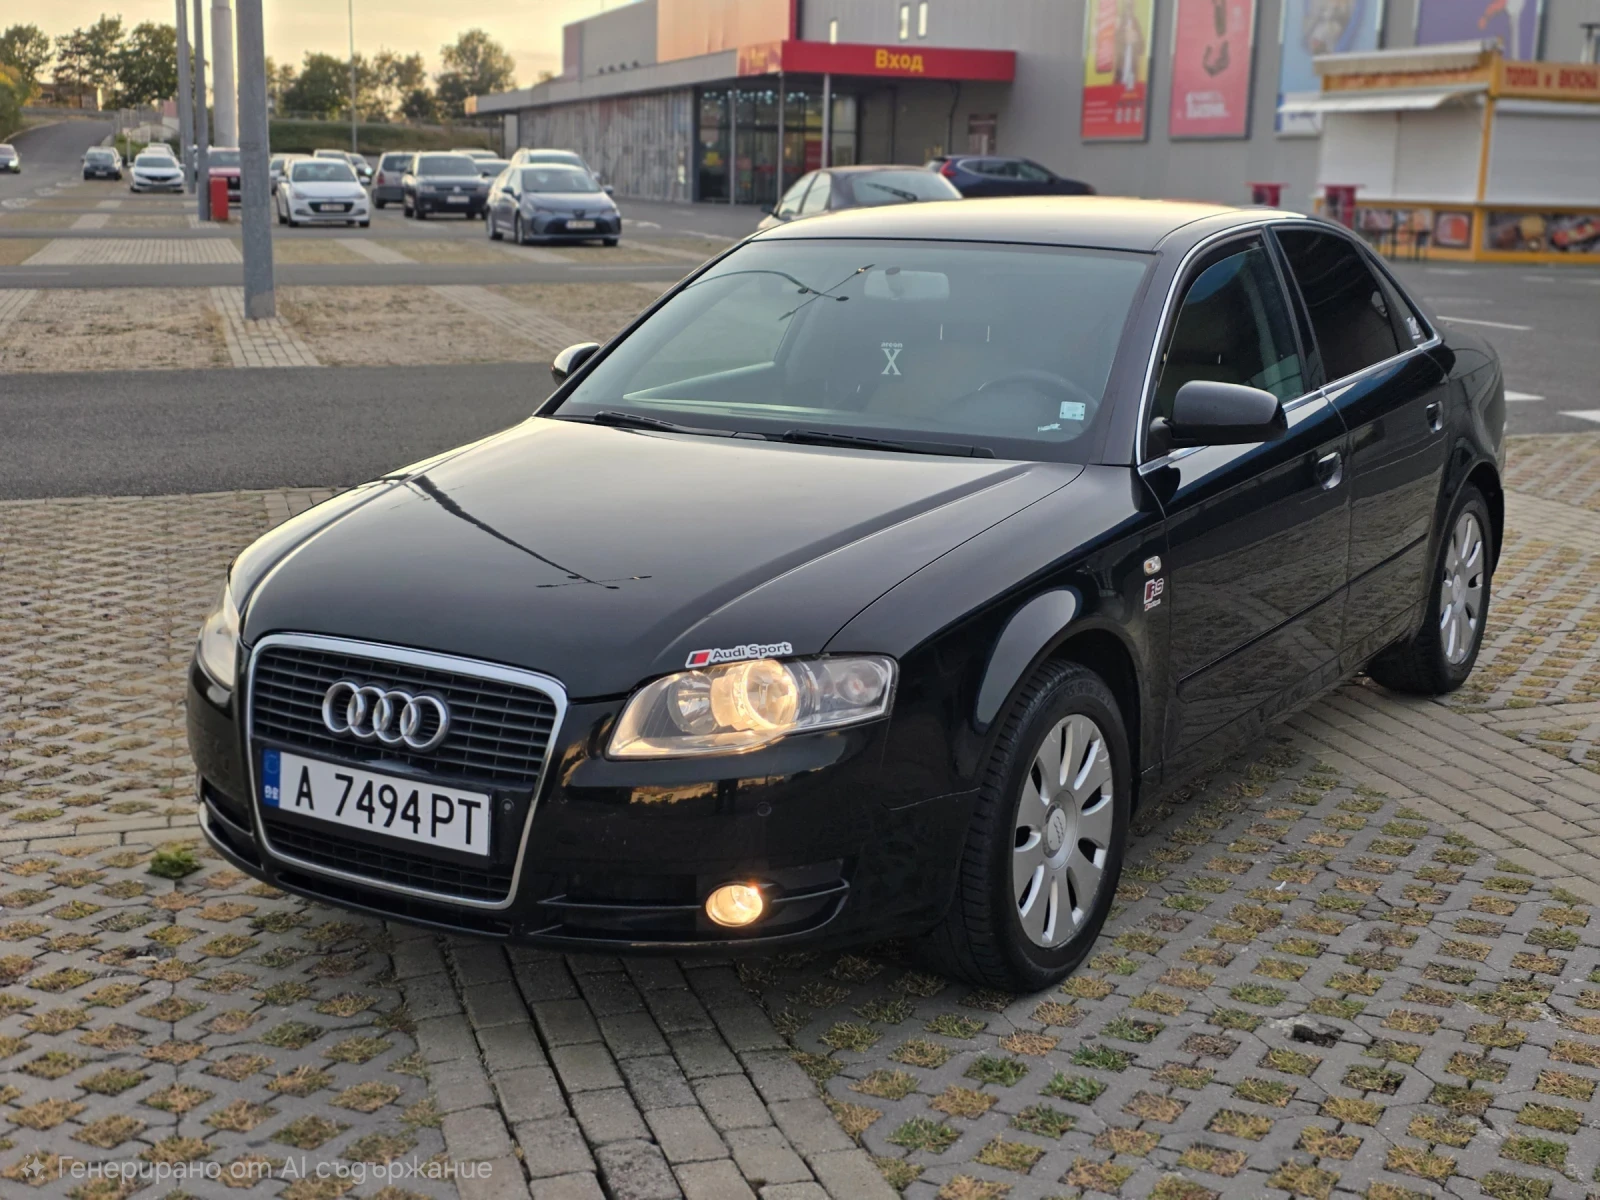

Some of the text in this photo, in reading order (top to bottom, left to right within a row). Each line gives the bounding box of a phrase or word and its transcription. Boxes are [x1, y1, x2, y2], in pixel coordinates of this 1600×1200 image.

[875, 49, 924, 72] Вход
[881, 348, 902, 375] X
[713, 644, 790, 660] Audi Sport
[295, 765, 314, 810] A
